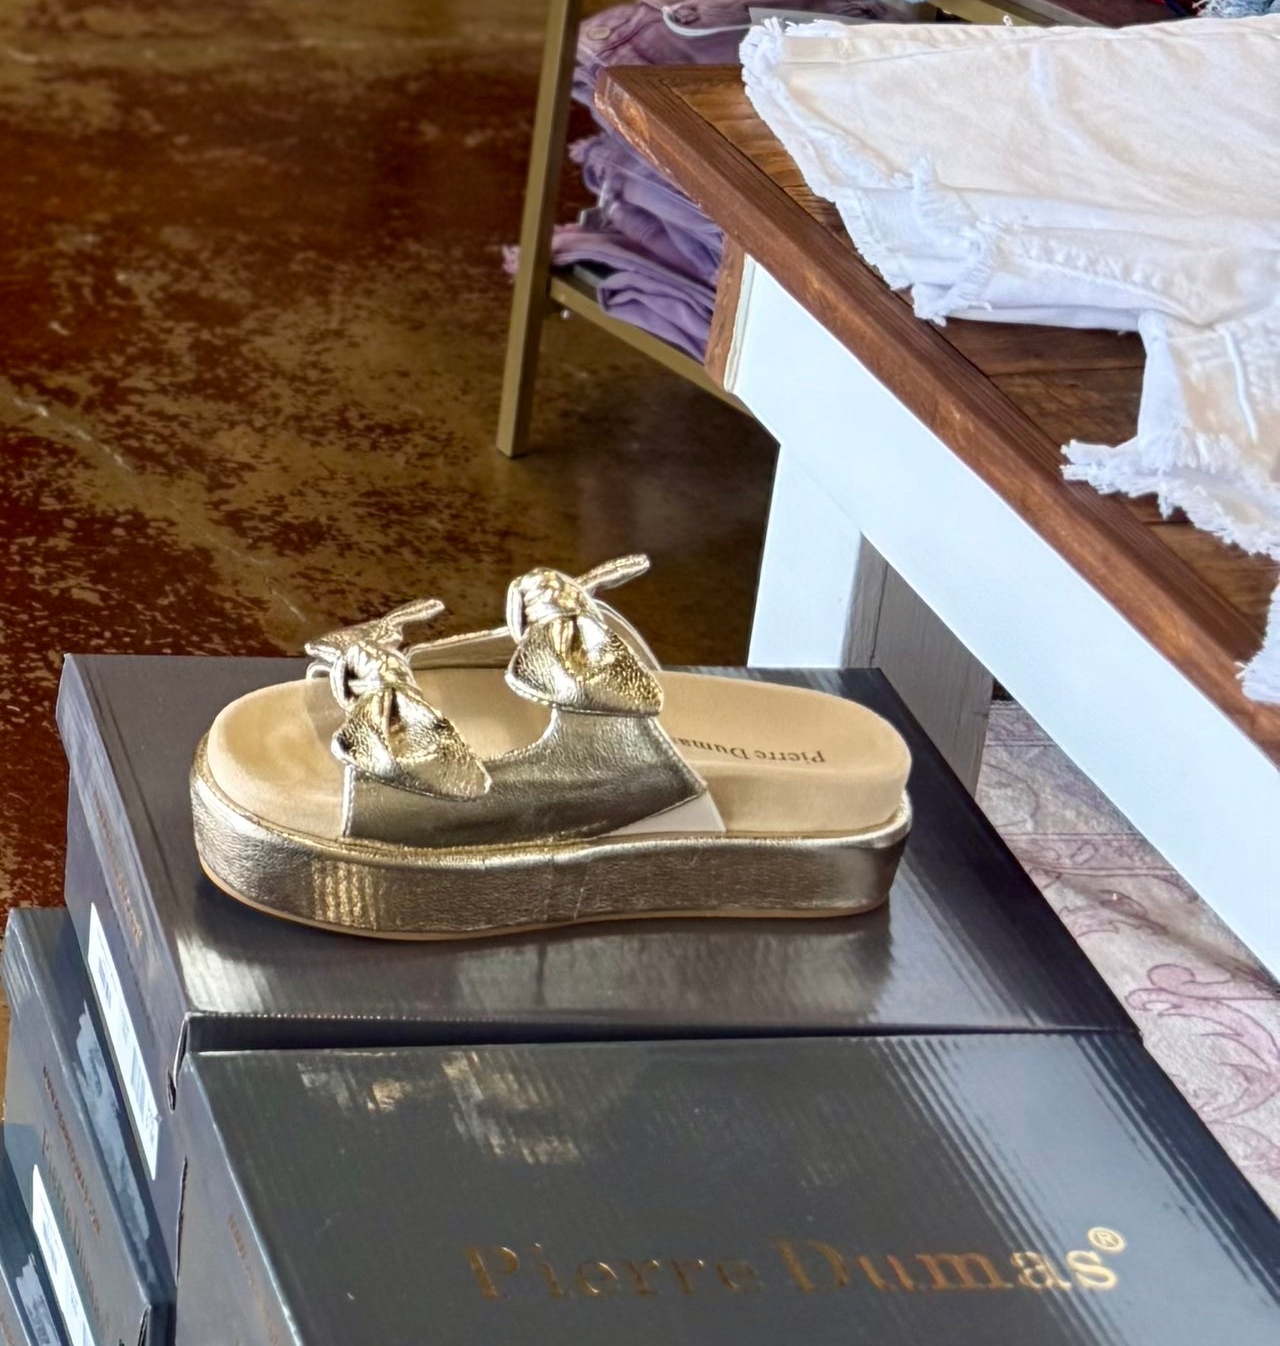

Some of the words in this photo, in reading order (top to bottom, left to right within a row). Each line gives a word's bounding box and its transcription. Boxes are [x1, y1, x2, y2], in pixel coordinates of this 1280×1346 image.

[672, 736, 751, 760] Duma
[756, 749, 827, 765] Pierre
[463, 1242, 764, 1301] Pierre
